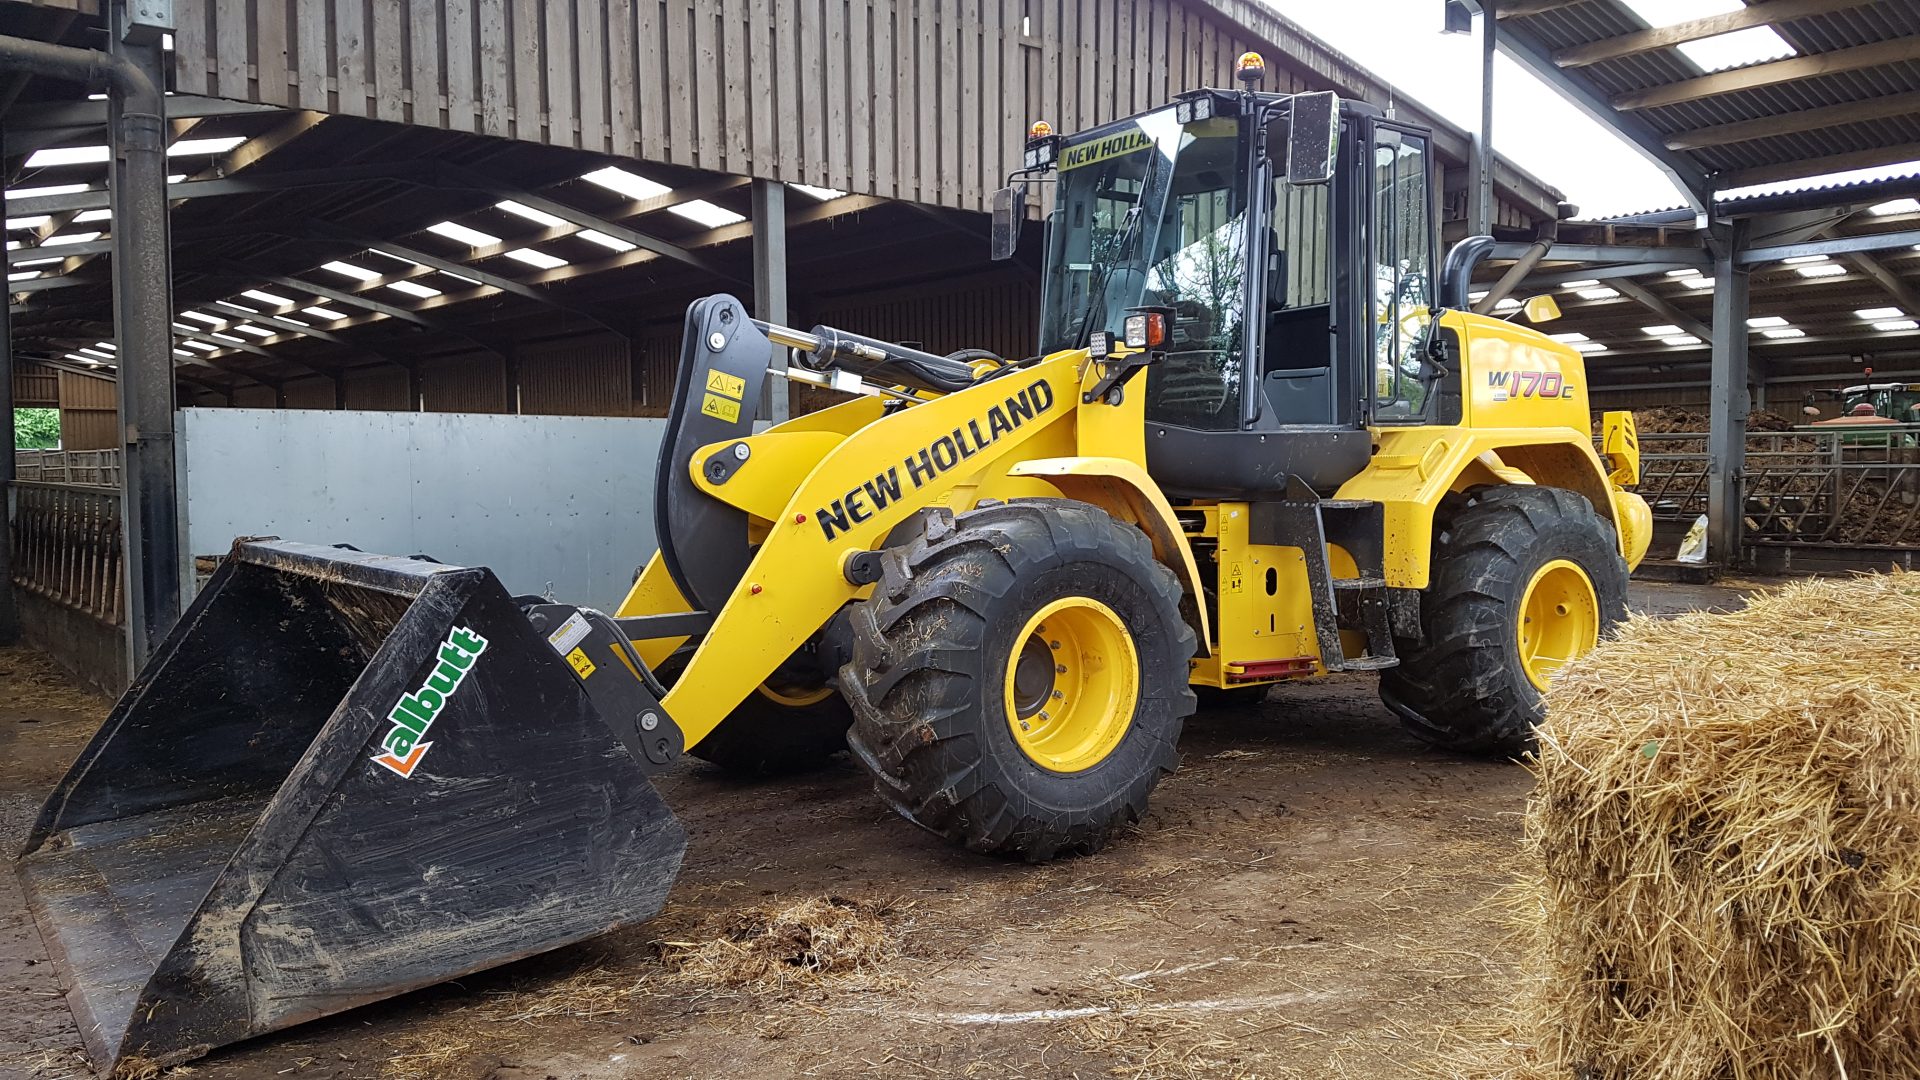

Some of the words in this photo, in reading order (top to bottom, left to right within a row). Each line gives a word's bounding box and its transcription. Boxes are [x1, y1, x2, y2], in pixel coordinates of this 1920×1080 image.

[1066, 144, 1099, 167] NEW
[815, 465, 903, 542] NEW
[904, 378, 1054, 489] HOLLAND
[385, 630, 484, 758] albutt
